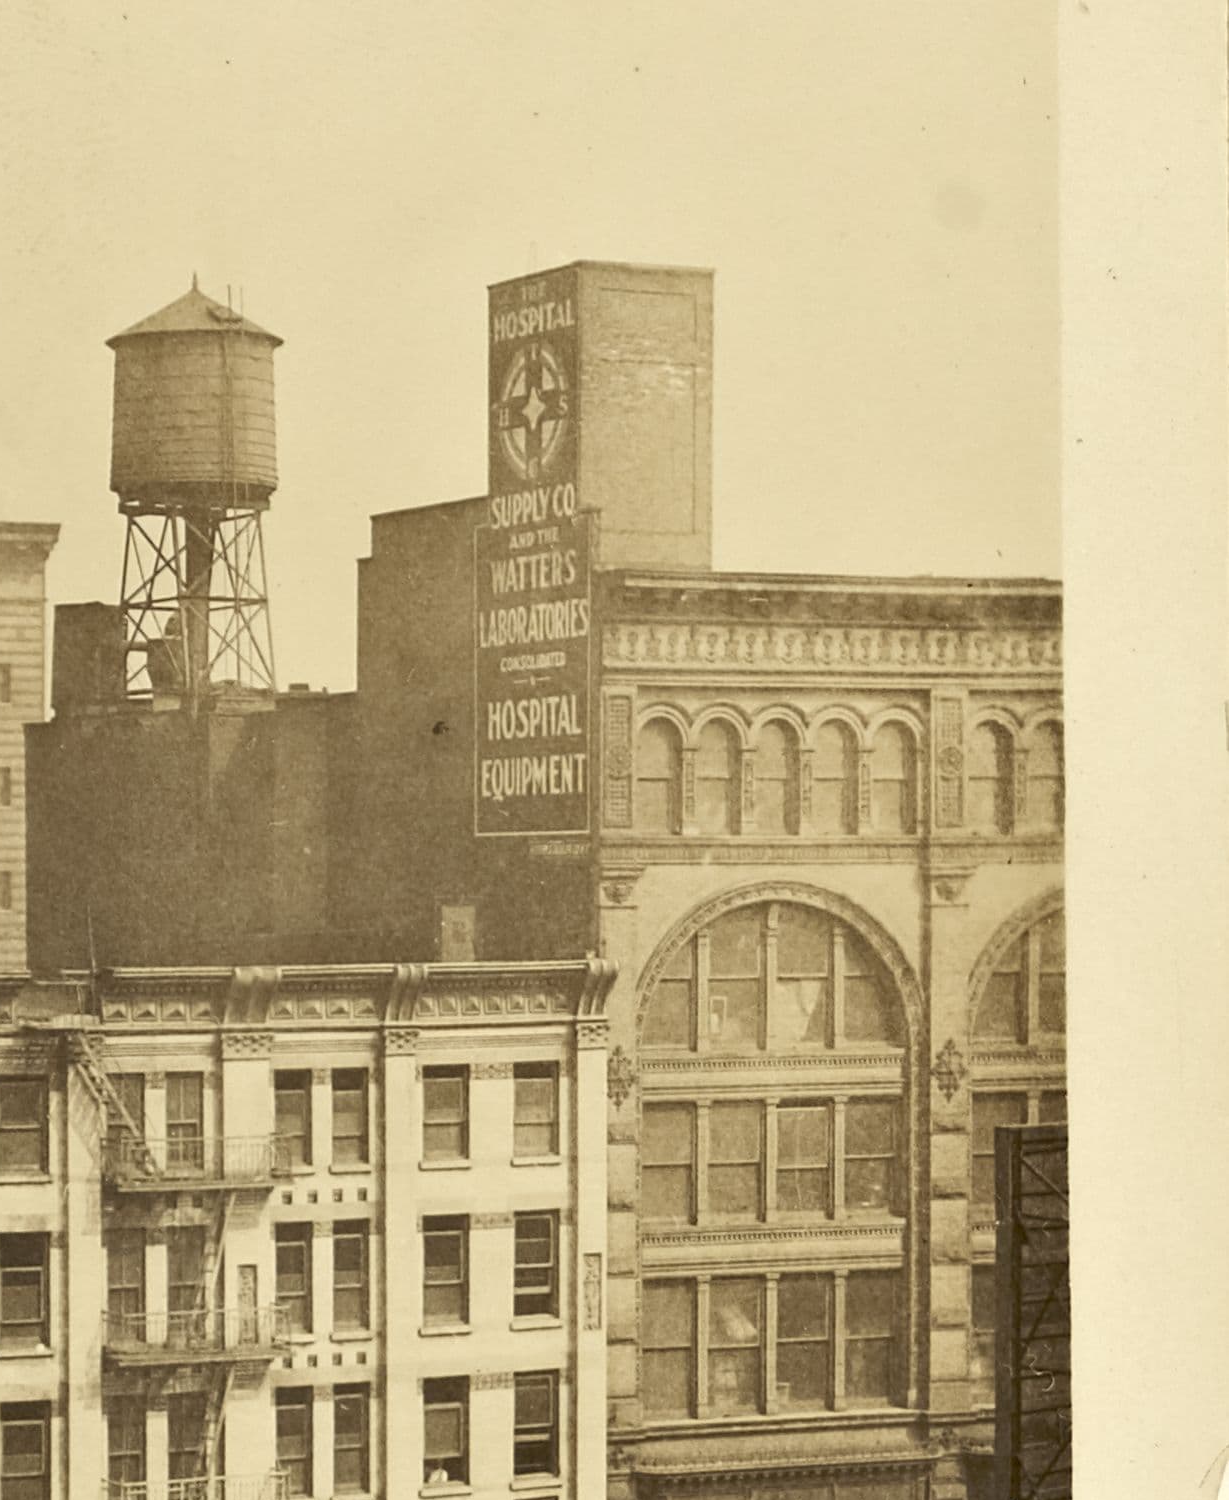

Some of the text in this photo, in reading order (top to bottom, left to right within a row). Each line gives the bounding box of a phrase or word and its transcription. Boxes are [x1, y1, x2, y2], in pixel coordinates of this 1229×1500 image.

[492, 299, 576, 343] HOSPITAL
[491, 487, 550, 529] SUPPLY
[509, 526, 559, 549] AND THE
[490, 549, 576, 594] WATTERS
[479, 598, 589, 648] LABORATORIES
[500, 651, 567, 673] CONSOLIDATED
[487, 694, 582, 741] HOSPITAL
[481, 753, 586, 802] EQUIPMENT
